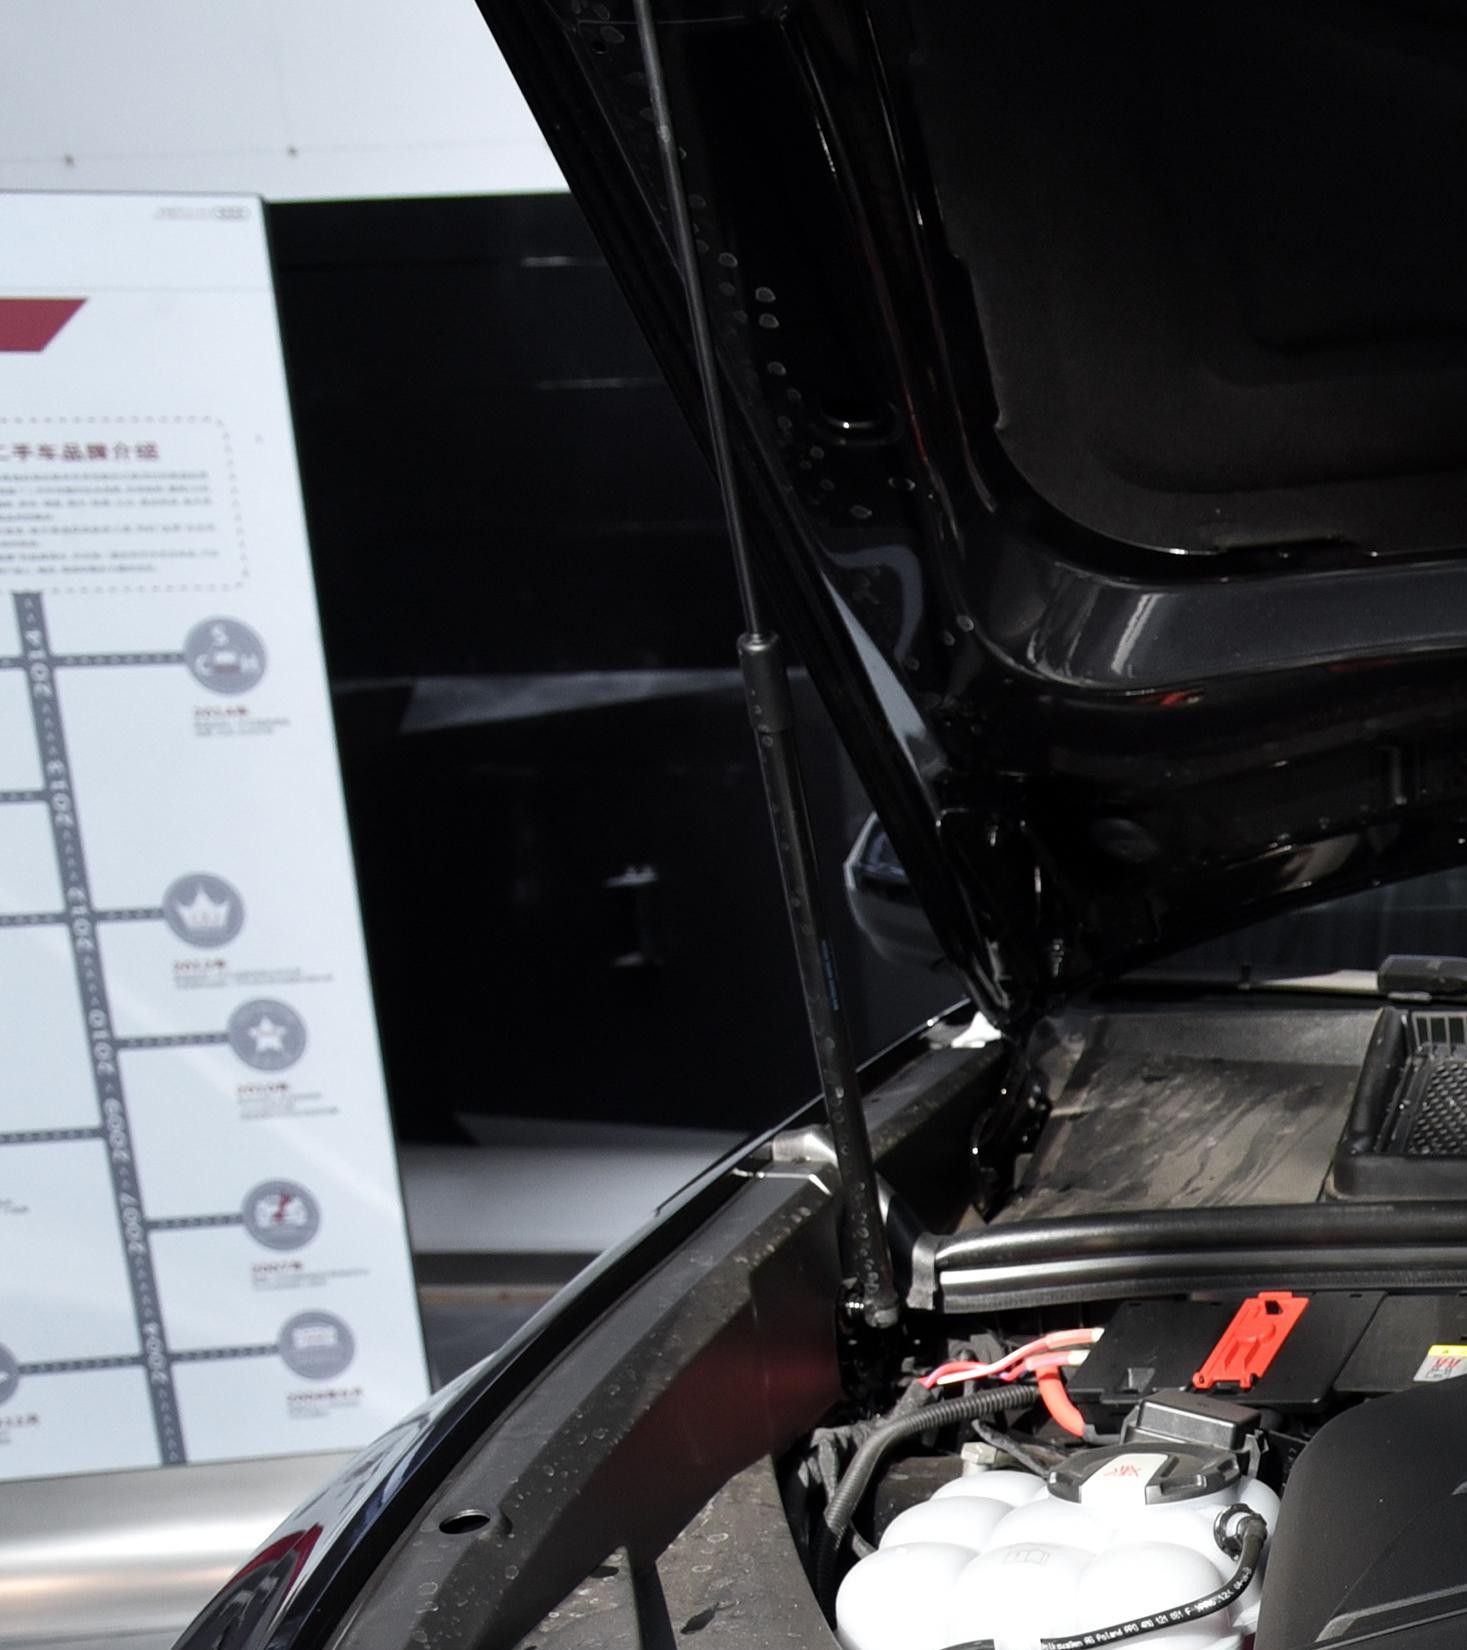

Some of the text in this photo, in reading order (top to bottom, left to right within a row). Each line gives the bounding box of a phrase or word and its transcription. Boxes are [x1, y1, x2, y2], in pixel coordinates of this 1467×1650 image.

[87, 1008, 116, 1076] 2010
[119, 1191, 146, 1256] 2007
[1095, 1628, 1123, 1642] Poland
